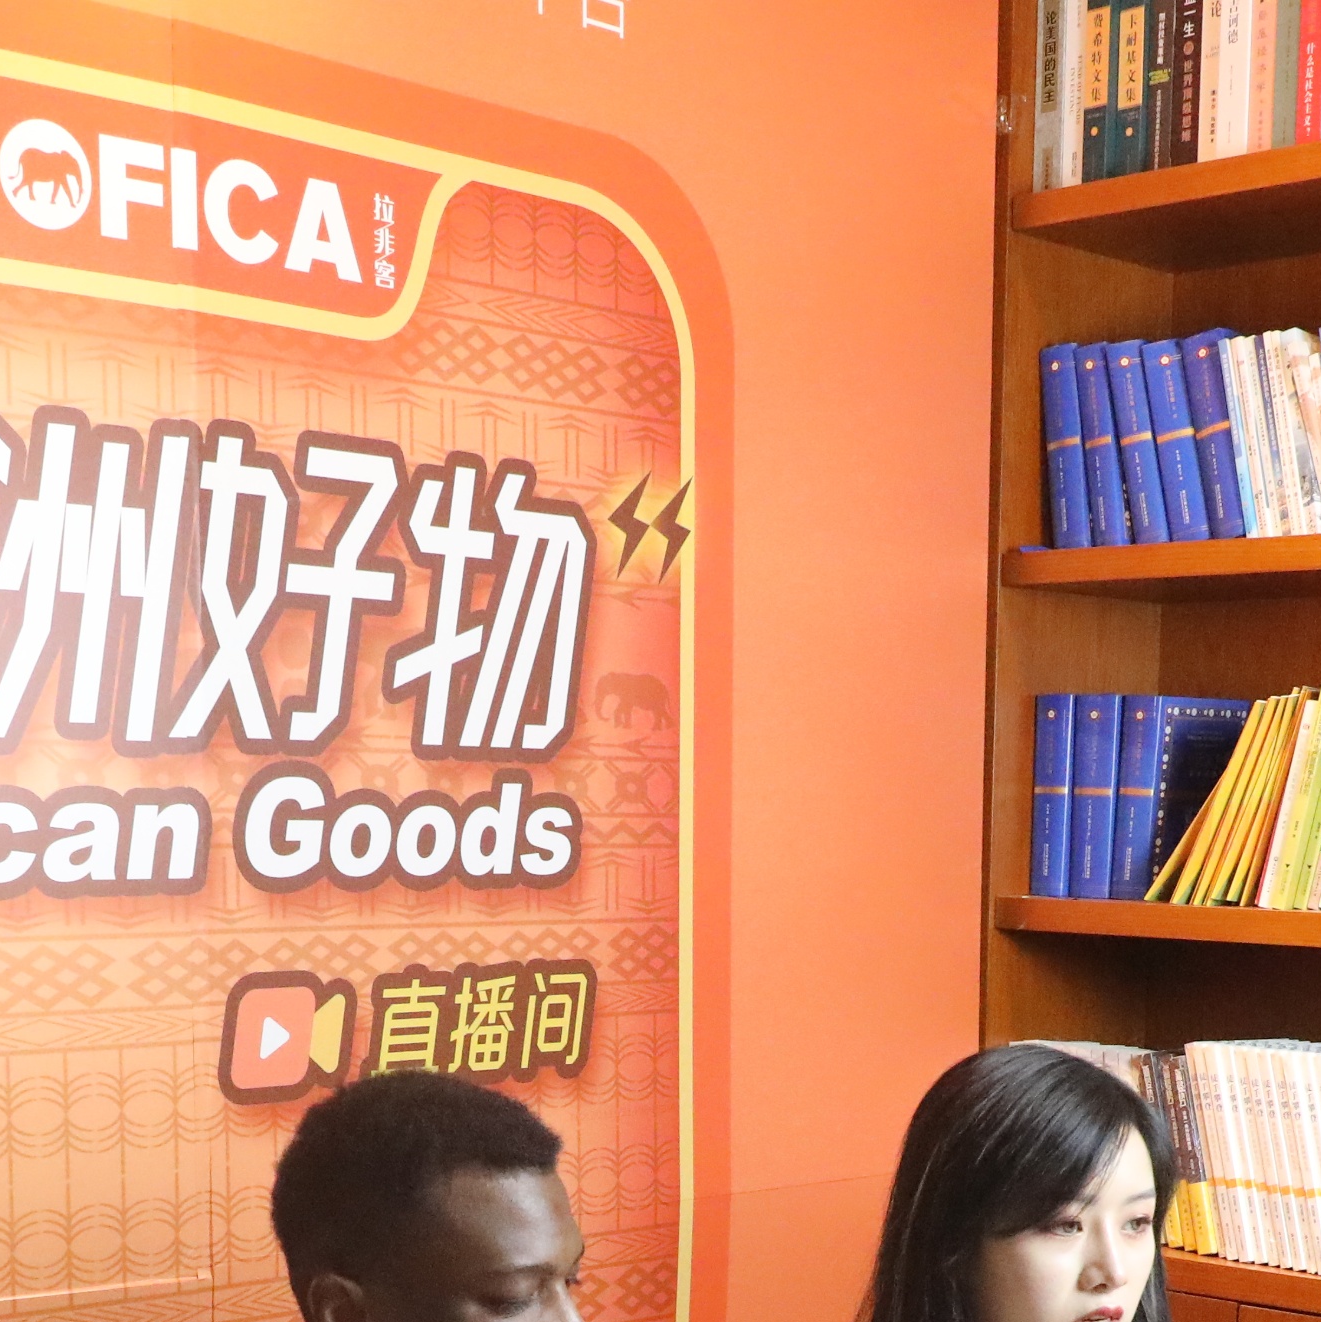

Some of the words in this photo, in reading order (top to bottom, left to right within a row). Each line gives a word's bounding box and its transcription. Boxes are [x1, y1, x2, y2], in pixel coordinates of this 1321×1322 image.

[1041, 10, 1057, 104] 论美国的民主
[1090, 12, 1103, 103] 费希特文集
[371, 191, 397, 291] 拉非客
[242, 775, 575, 882] Goods
[369, 970, 590, 1076] 直播间
